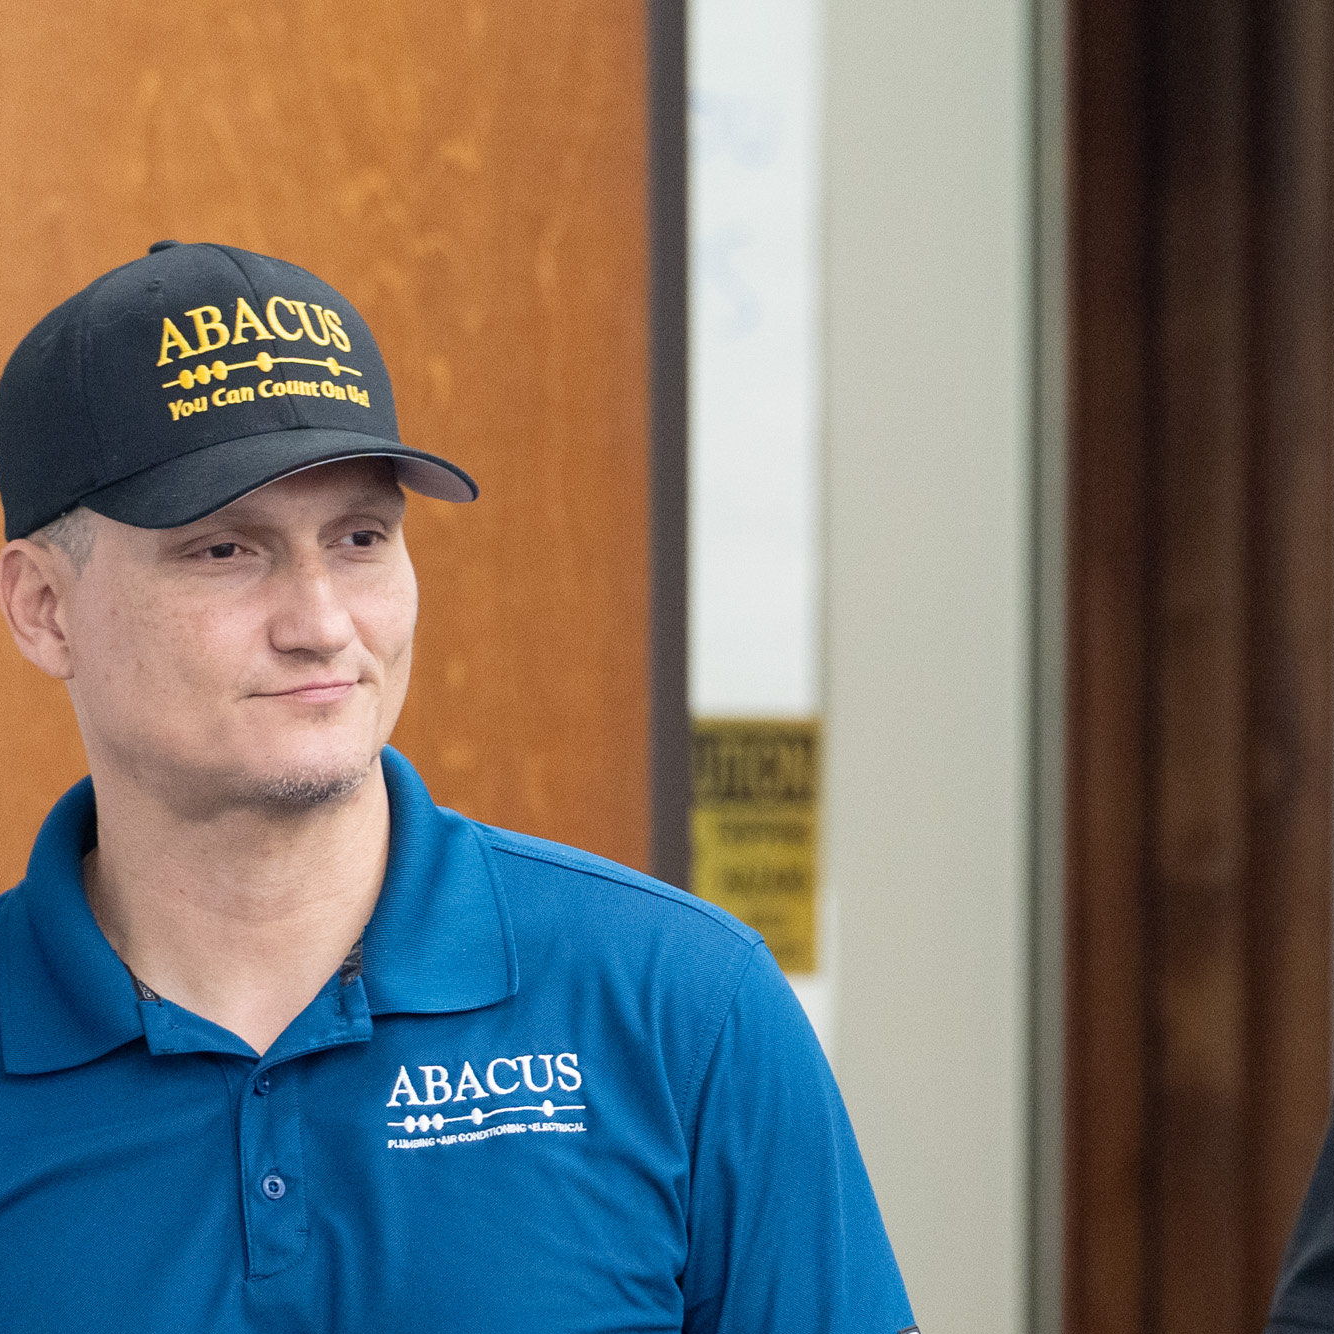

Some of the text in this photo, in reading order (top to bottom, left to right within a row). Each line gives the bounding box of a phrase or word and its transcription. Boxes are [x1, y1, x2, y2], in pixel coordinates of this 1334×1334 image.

[156, 295, 352, 367] ABACUS
[168, 396, 208, 421] You
[211, 386, 255, 407] Can
[257, 379, 320, 399] Count
[320, 380, 347, 401] On
[386, 1052, 582, 1107] ABACUS
[387, 1137, 436, 1149] PLUMBING
[458, 1123, 528, 1142] CONDITIONING
